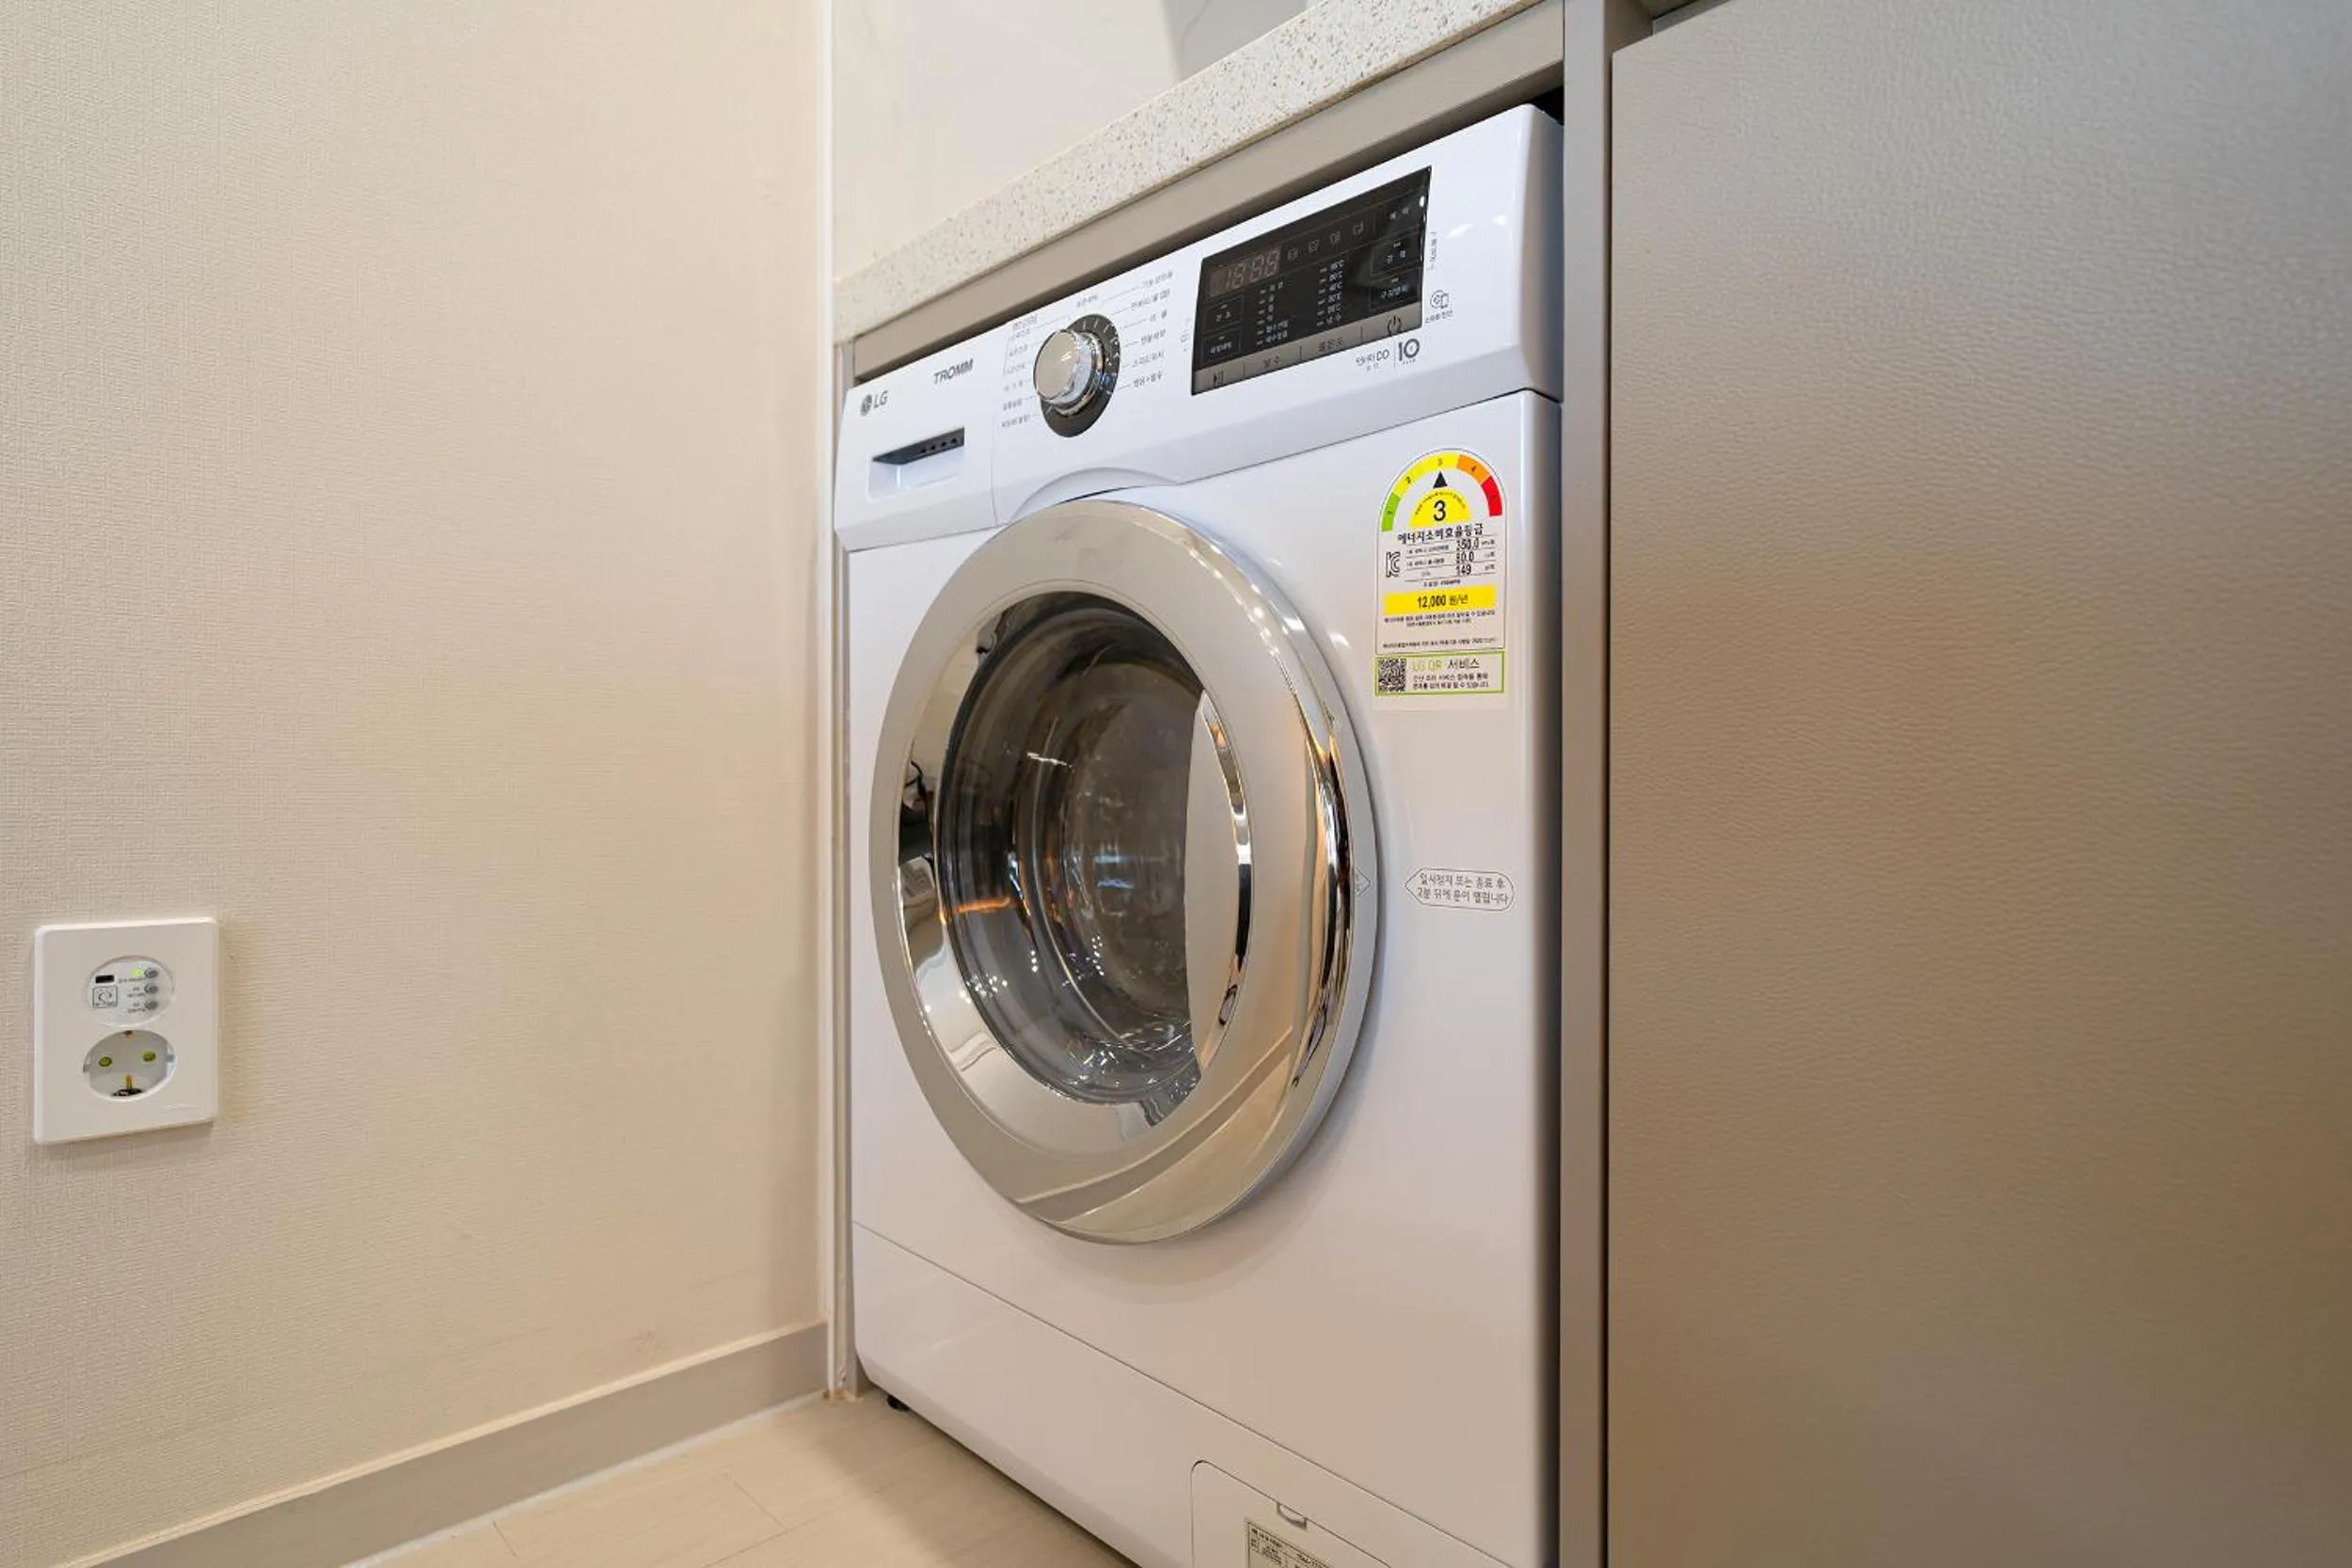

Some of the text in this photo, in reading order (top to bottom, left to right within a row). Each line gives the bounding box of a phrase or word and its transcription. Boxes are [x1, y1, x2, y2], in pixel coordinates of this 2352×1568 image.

[1398, 338, 1421, 362] 10
[932, 358, 975, 385] TROMM
[872, 390, 889, 410] LG
[1433, 499, 1447, 522] 3
[1397, 523, 1484, 545] 에너지소비효율등급
[1417, 594, 1447, 609] 12,000
[1412, 659, 1425, 672] LG
[1447, 658, 1481, 670] 서비스
